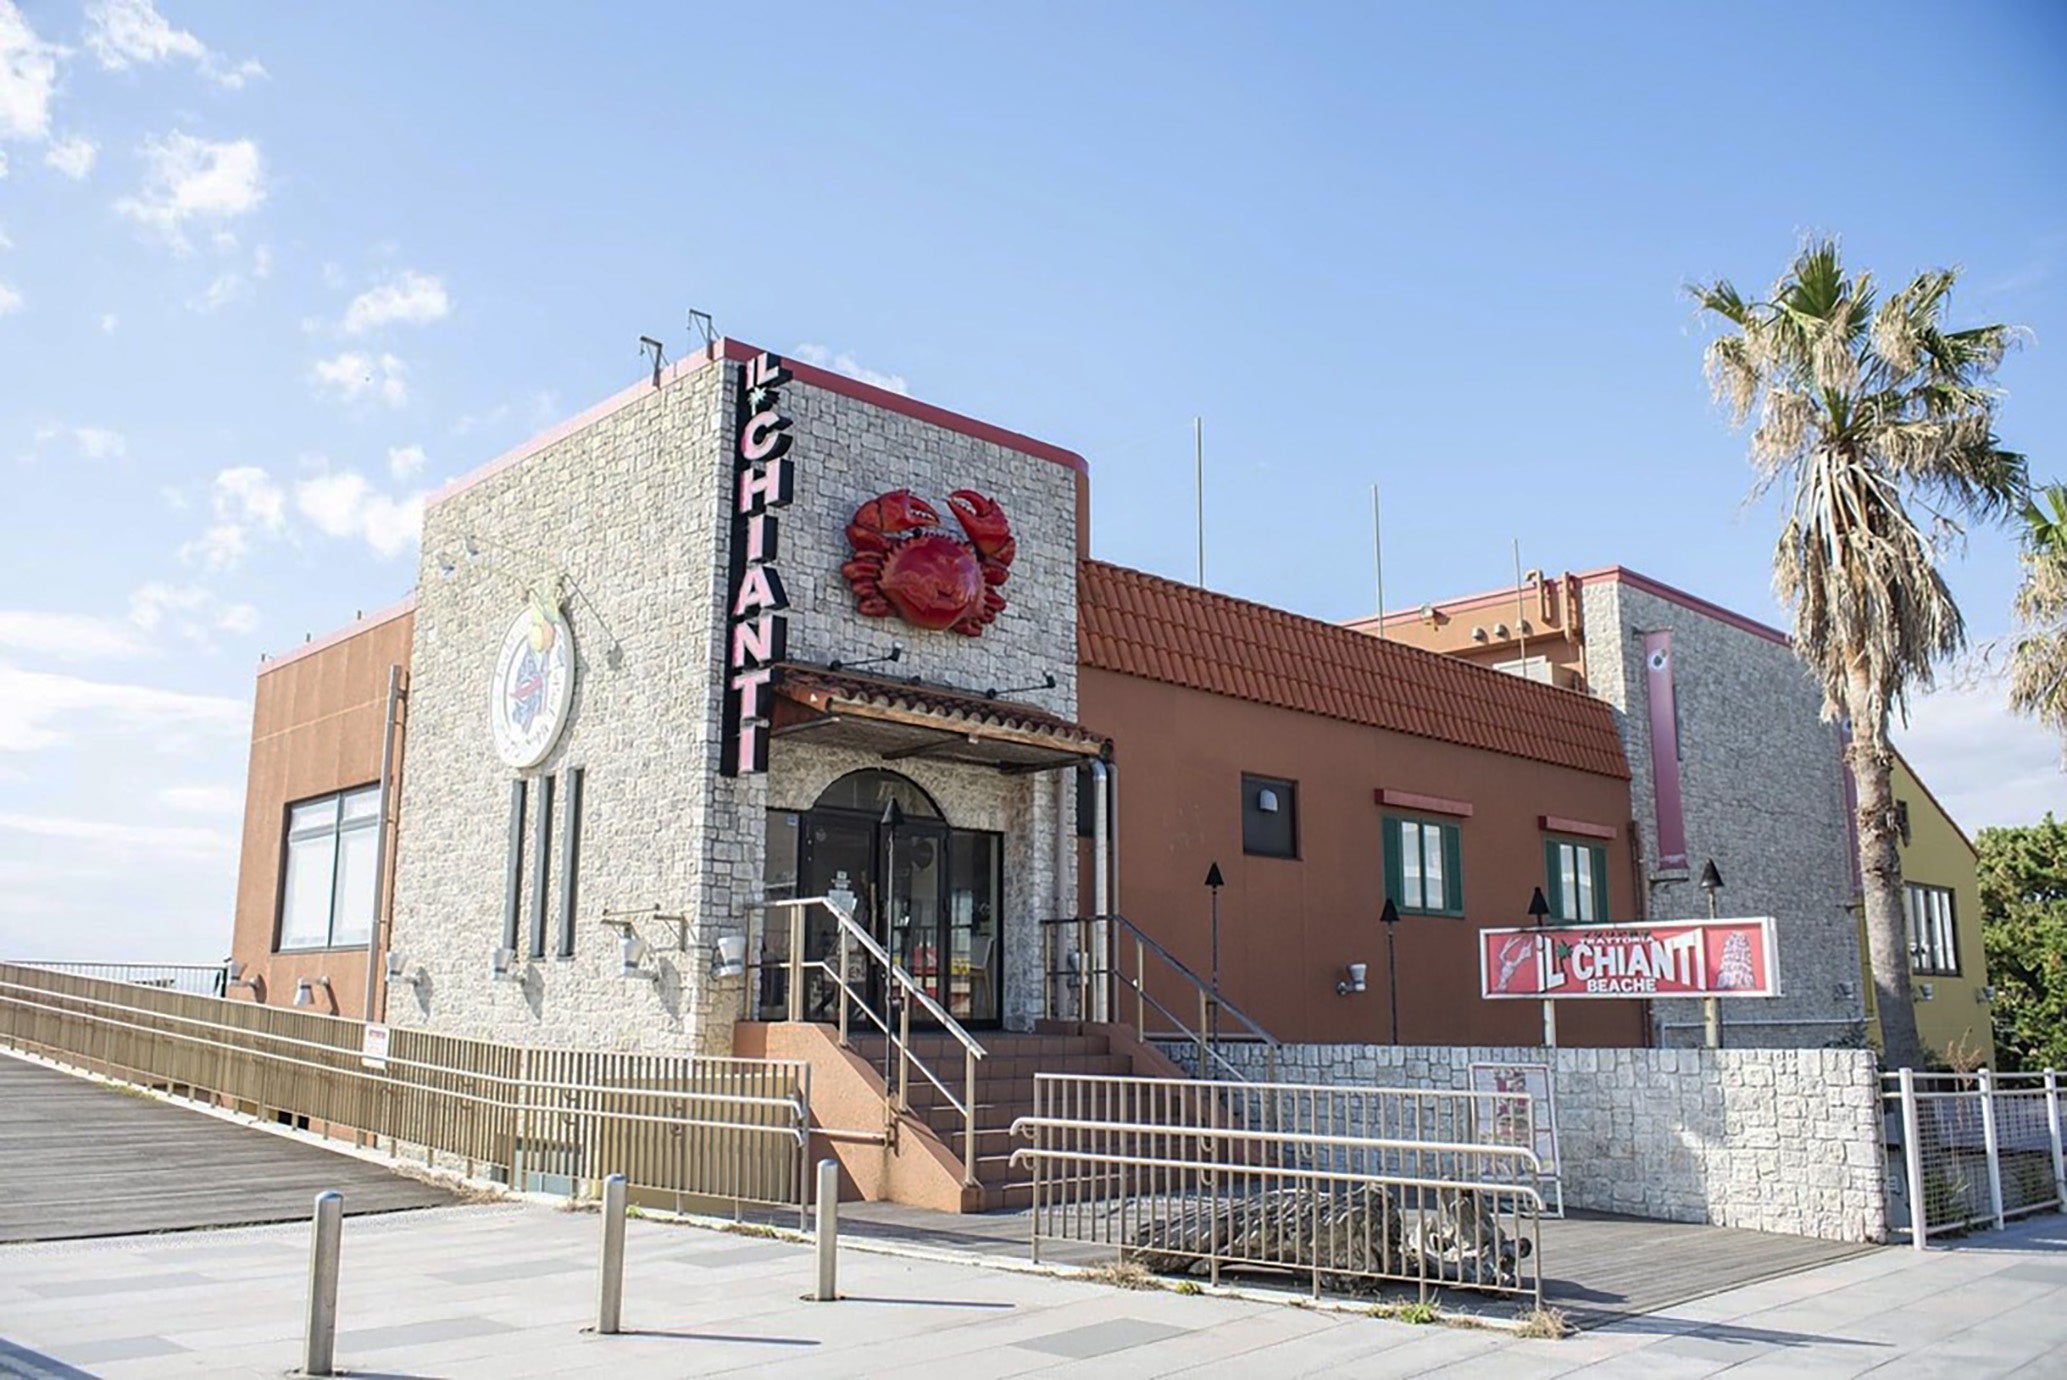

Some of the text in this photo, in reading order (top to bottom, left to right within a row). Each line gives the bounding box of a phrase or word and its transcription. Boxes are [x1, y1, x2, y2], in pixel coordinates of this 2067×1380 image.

[732, 410, 785, 773] CHIANTI
[1571, 927, 1706, 990] CHIANTI
[1587, 978, 1657, 993] BEACHE
